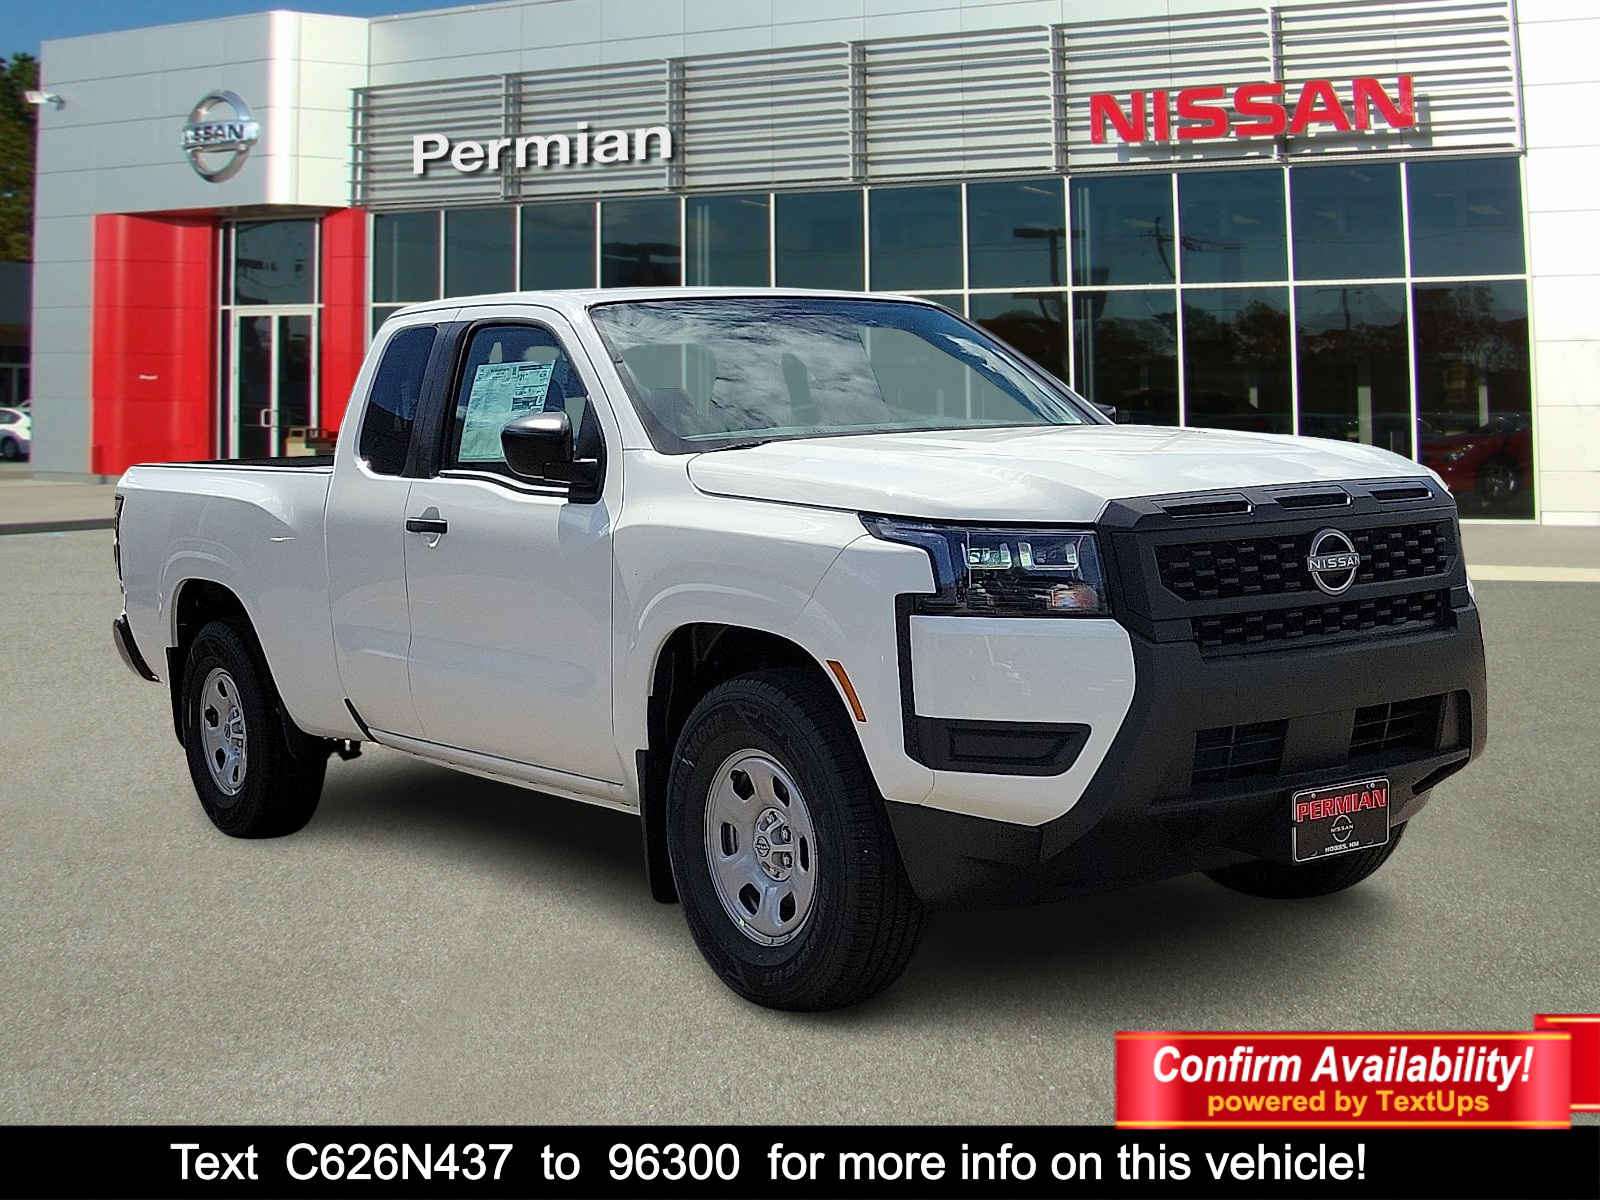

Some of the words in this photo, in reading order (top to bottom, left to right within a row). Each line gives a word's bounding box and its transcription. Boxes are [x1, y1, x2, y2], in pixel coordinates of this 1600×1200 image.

[1089, 74, 1415, 144] NISSAN
[180, 124, 245, 143] SSAN
[413, 122, 672, 175] Permian
[1309, 556, 1360, 569] NISSAN
[1296, 788, 1387, 823] PERMIAN
[1330, 824, 1354, 833] NISSAN
